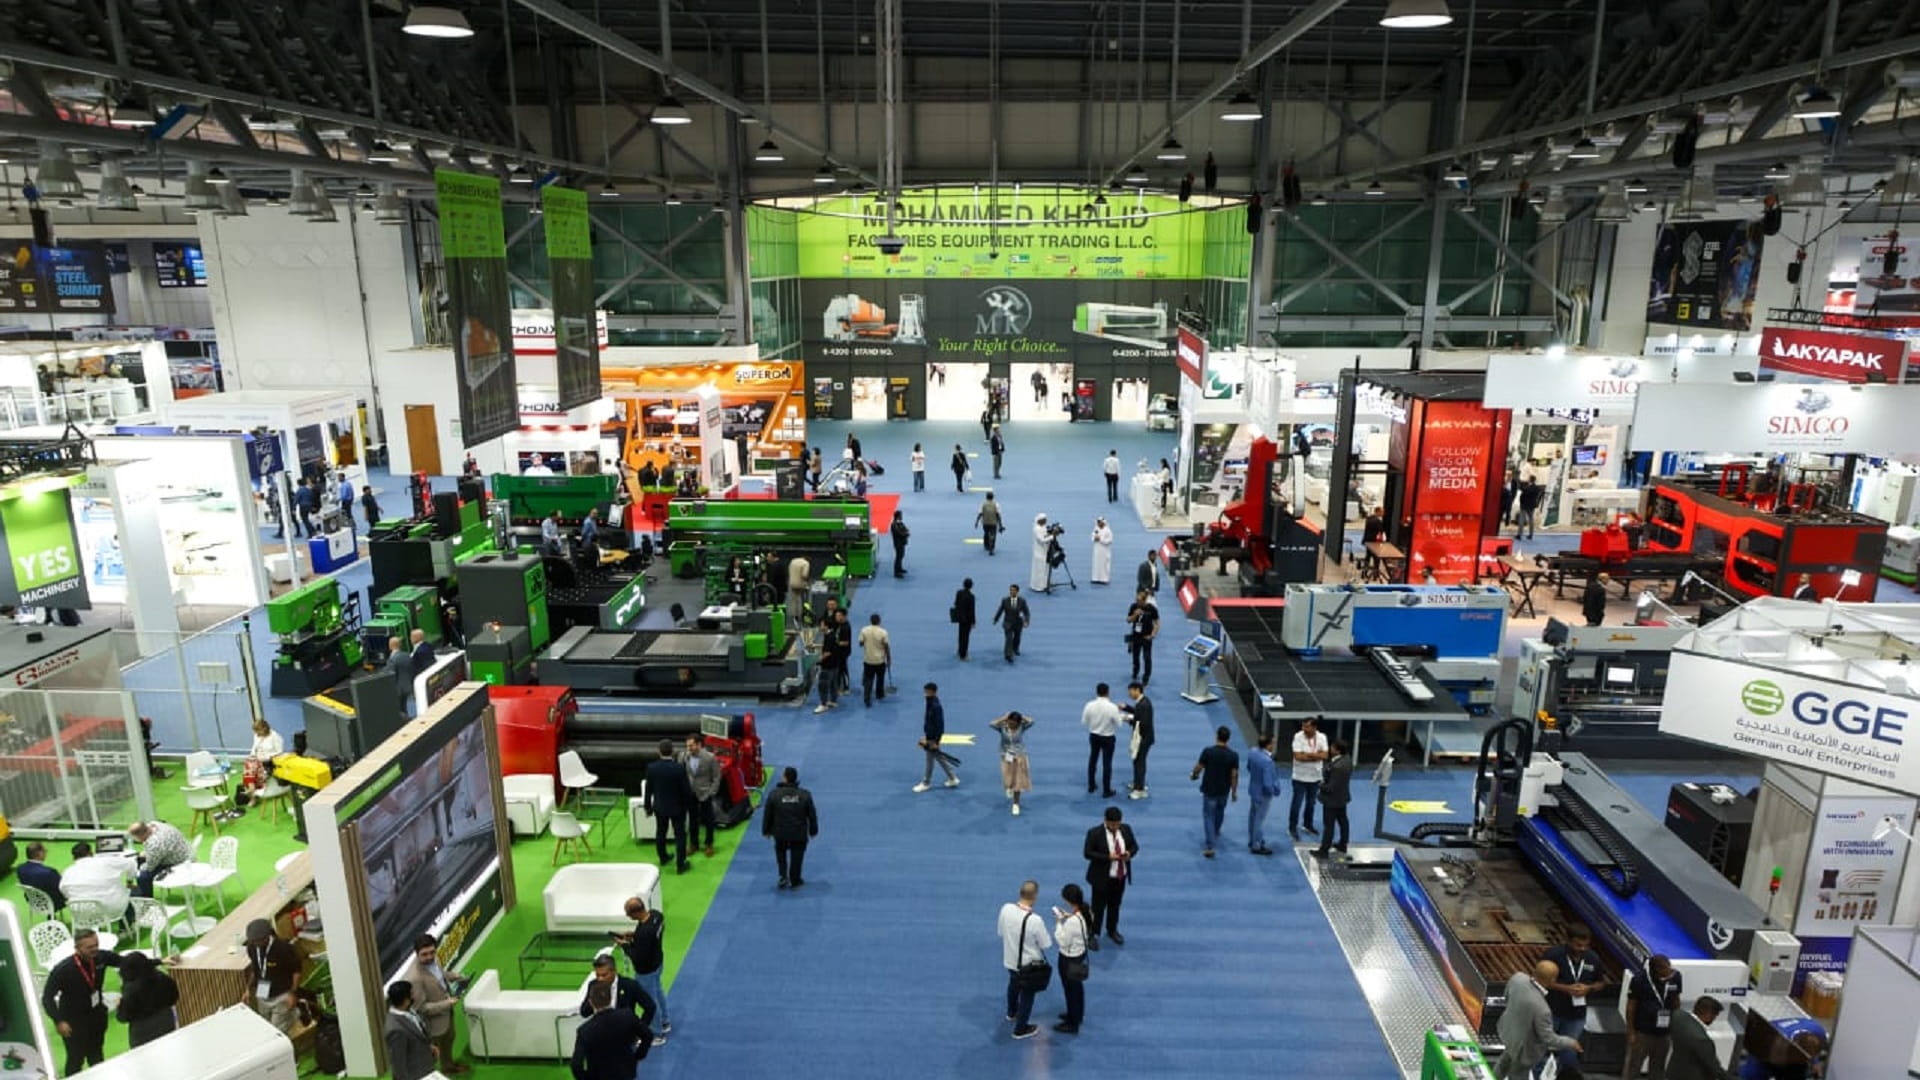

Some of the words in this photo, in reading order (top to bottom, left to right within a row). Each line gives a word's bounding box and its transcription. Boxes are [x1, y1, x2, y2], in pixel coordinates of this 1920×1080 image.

[862, 205, 1033, 228] MOHAMMED
[1043, 205, 1149, 228] KHALID
[849, 233, 937, 248] FACRIES
[941, 234, 1036, 248] EQUIPMENT
[1040, 234, 1110, 248] TRADING
[1114, 235, 1158, 248] L.L.C.
[54, 271, 89, 283] STEEL
[57, 284, 104, 295] SUMMIT
[938, 337, 968, 352] Your
[972, 337, 1009, 356] Right
[1010, 336, 1068, 353] Choice...
[1786, 343, 1886, 370] AKYAPAK
[1589, 380, 1638, 394] SIMC
[1767, 416, 1849, 434] SIMCO
[1432, 447, 1481, 456] FOLLOW
[1430, 467, 1478, 477] SOCIAL
[1429, 478, 1477, 488] MEDIA
[18, 546, 72, 582] YES
[21, 577, 80, 604] MACHINERY
[1427, 594, 1468, 604] SIMCO
[1791, 690, 1909, 746] GGE
[1733, 731, 1784, 751] German
[1787, 743, 1814, 759] Gulf
[1816, 751, 1896, 779] Enterprises
[1835, 840, 1887, 848] TECHNOLOGY
